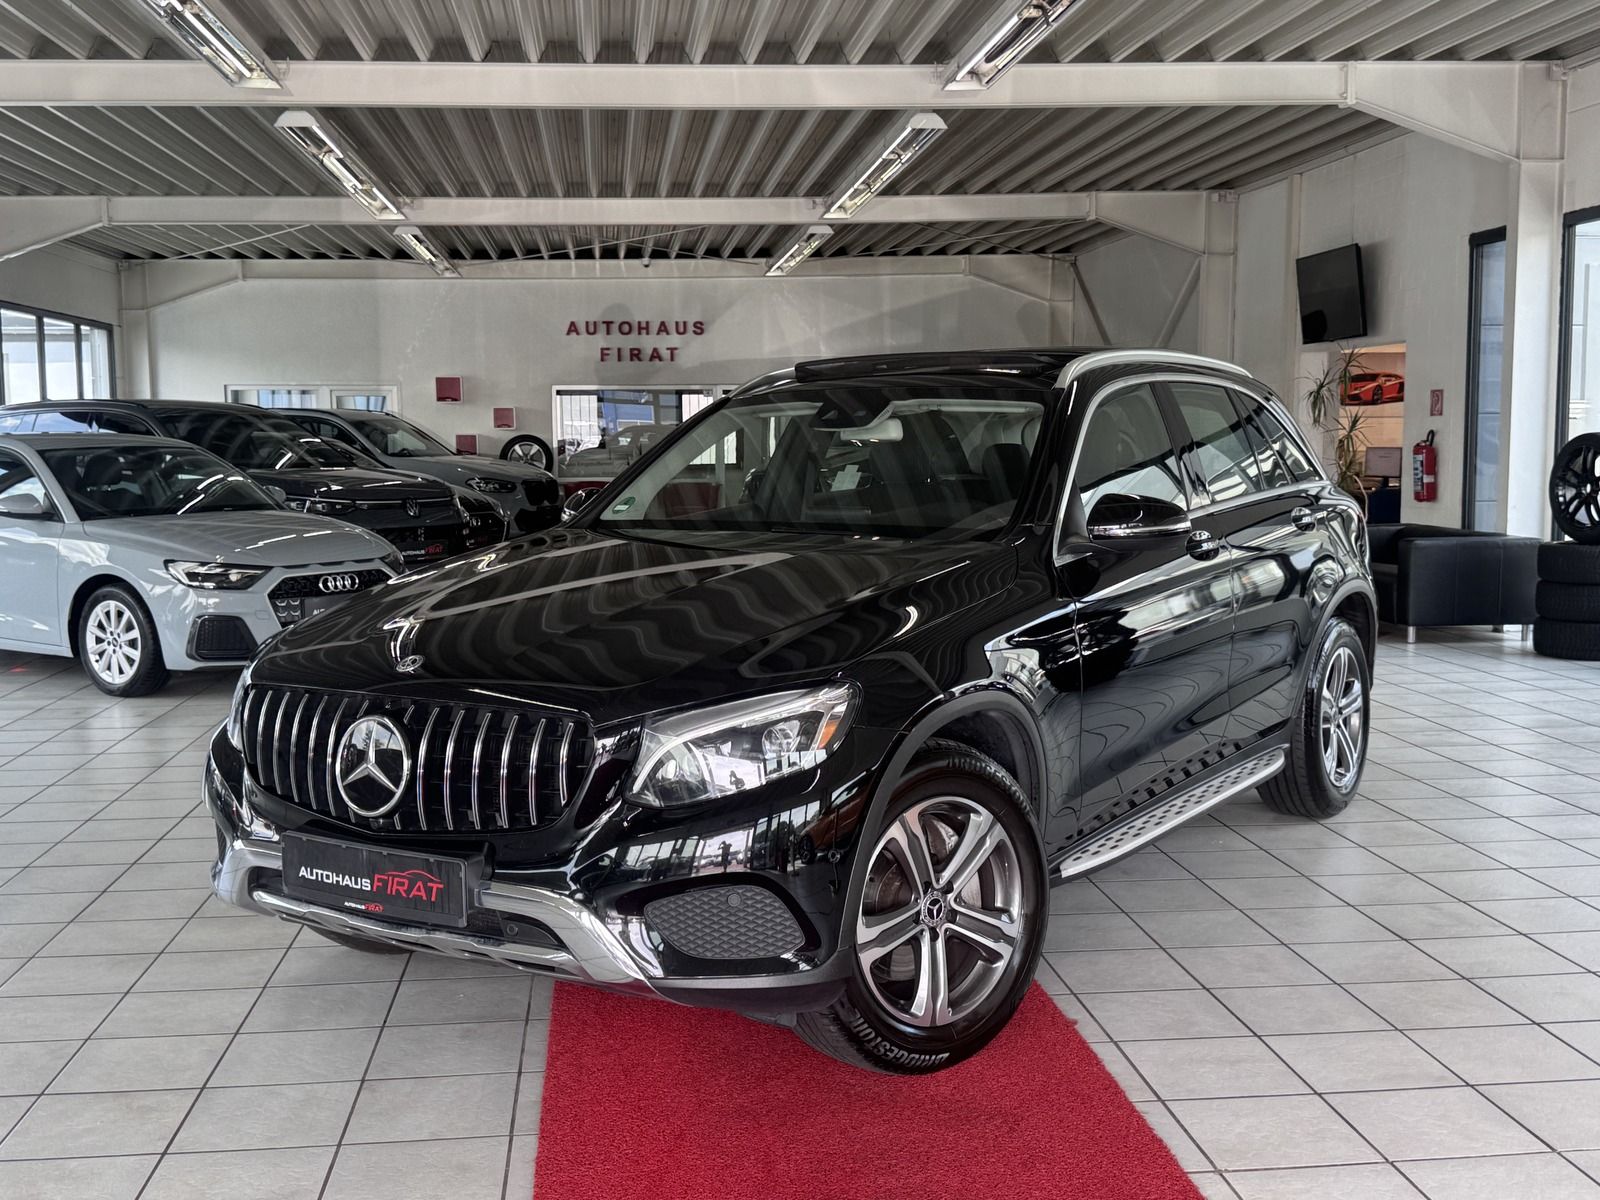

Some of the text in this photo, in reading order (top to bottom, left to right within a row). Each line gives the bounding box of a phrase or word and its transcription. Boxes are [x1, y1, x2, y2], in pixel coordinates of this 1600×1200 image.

[566, 320, 705, 336] AUTOHAUS
[600, 347, 679, 362] FIRAT
[299, 866, 444, 903] AUTOHAUS FIRAT
